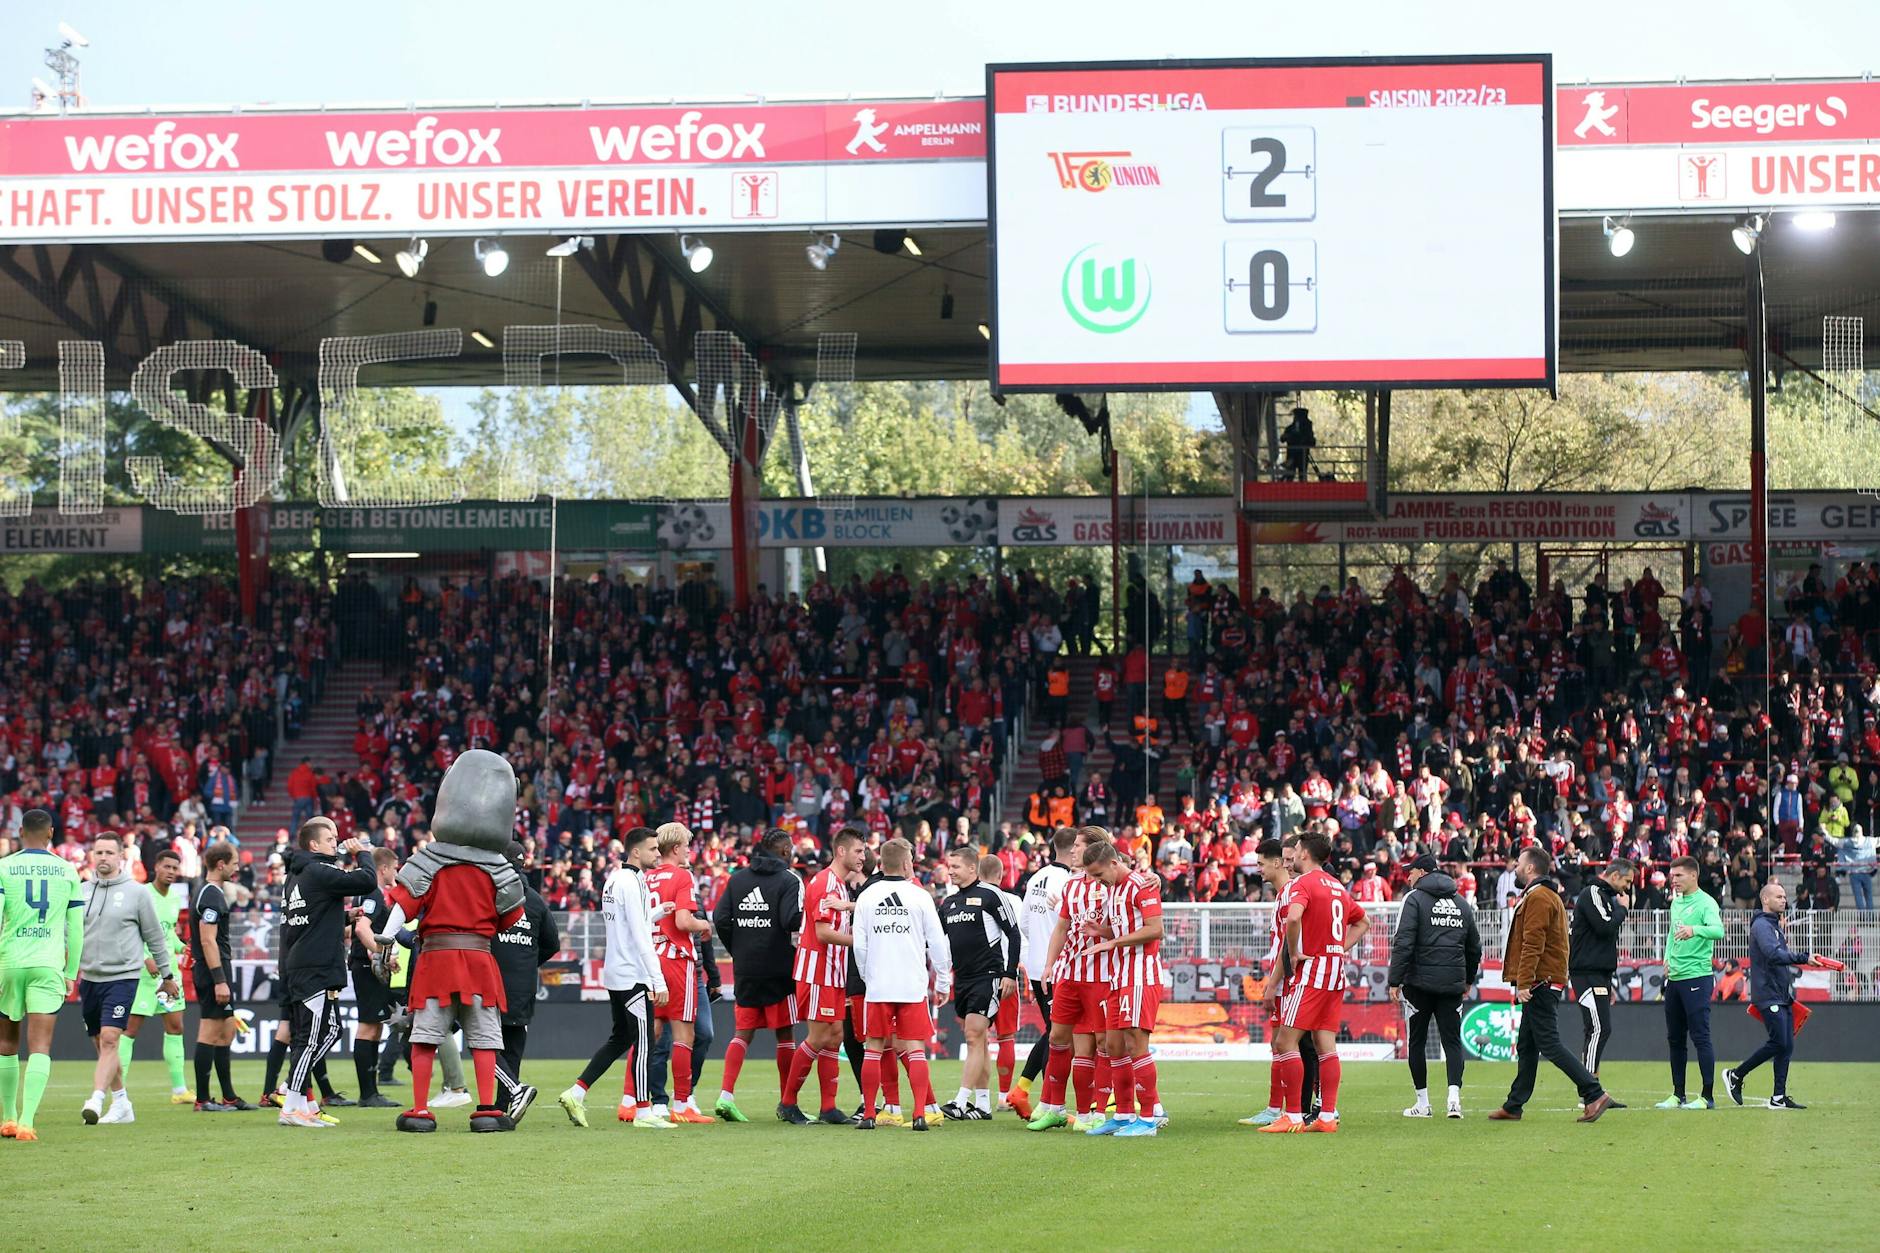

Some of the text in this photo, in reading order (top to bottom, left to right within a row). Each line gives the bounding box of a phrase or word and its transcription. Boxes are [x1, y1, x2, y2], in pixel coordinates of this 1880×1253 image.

[1054, 93, 1208, 112] BUNDESLIGA
[1369, 84, 1506, 108] SAISON 2022/23
[1691, 98, 1811, 133] Seeger
[589, 111, 766, 161] wefox
[894, 122, 981, 136] AMPELMANN
[65, 121, 240, 171] wefox
[326, 117, 502, 167] wefox
[921, 137, 954, 146] BERLIN
[1112, 166, 1160, 186] UNION
[1250, 138, 1287, 208] 2
[1751, 154, 1880, 195] UNSER
[0, 177, 707, 227] HAFT. UNSER STOLZ. UNSER VEREIN.
[1250, 250, 1289, 321] 0
[834, 507, 913, 522] FAMILIEN
[1387, 501, 1456, 518] AMME
[1489, 502, 1562, 518] REGION
[1565, 503, 1590, 517] FÜR
[1595, 506, 1616, 517] DIE
[1709, 499, 1797, 533] SPEE
[5, 528, 109, 548] ELEMENT
[834, 525, 892, 540] BLOCK
[9, 866, 65, 876] WOLFSBURG
[25, 879, 50, 923] 4
[738, 902, 769, 911] adidas
[875, 907, 909, 916] adidas
[946, 911, 976, 924] wefox
[1331, 898, 1343, 942] 8
[1432, 906, 1462, 916] adidas
[737, 916, 771, 928] wefox
[873, 922, 911, 934] wefox
[1430, 916, 1463, 928] wefox
[498, 932, 532, 946] wefox
